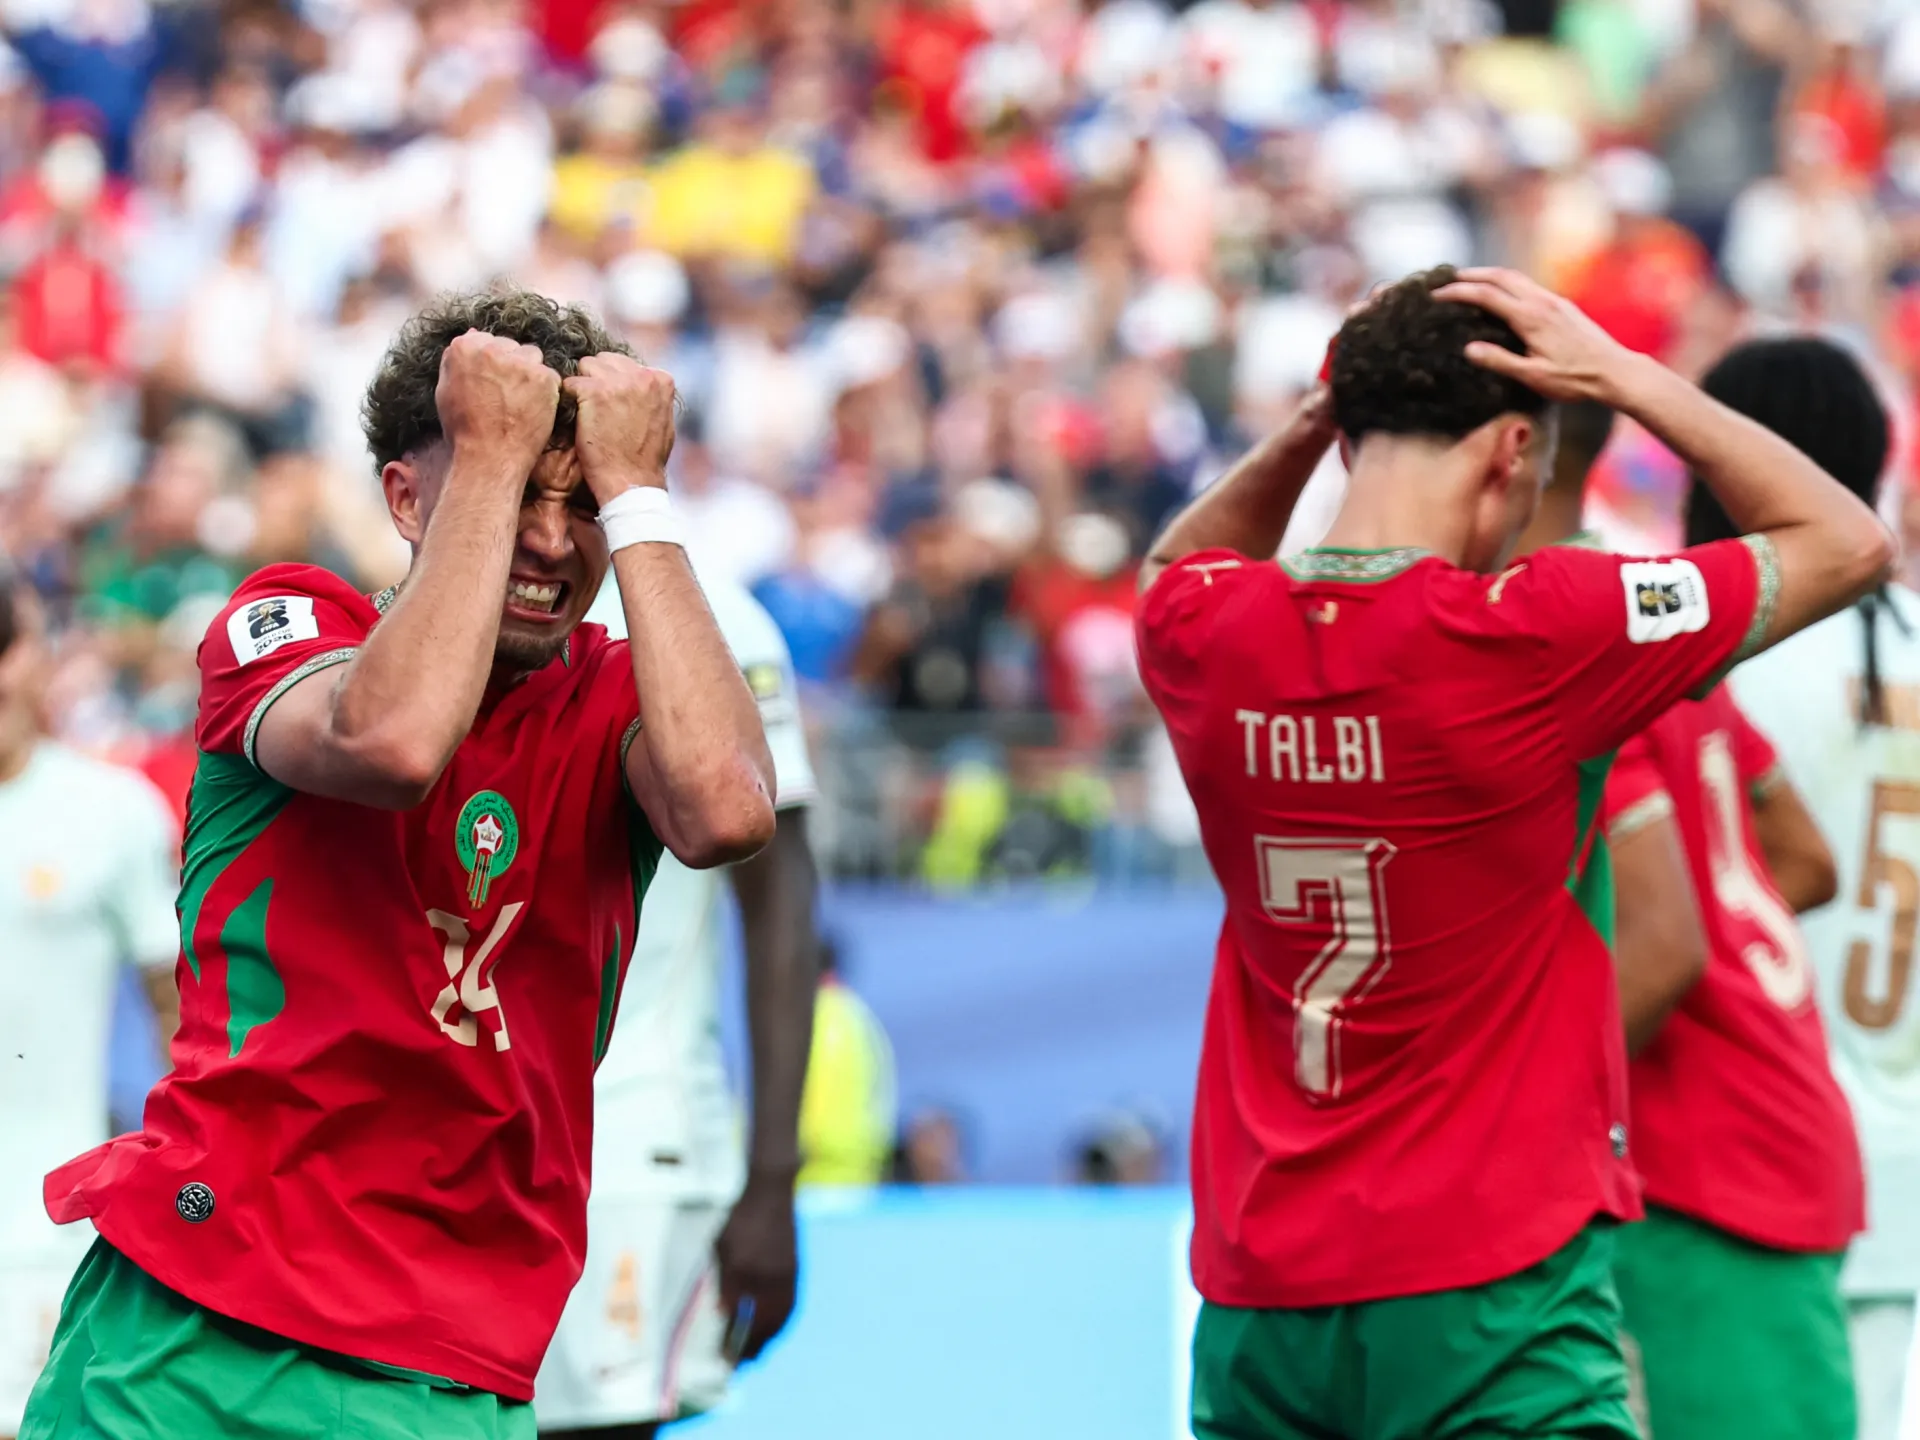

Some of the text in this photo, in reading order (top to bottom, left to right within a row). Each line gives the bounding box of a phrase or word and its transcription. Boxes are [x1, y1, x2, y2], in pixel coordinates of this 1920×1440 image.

[256, 633, 294, 656] 2026
[260, 622, 280, 634] FIFA
[1235, 708, 1385, 784] TALBI
[425, 901, 525, 1052] 24
[1254, 833, 1399, 1104] 7
